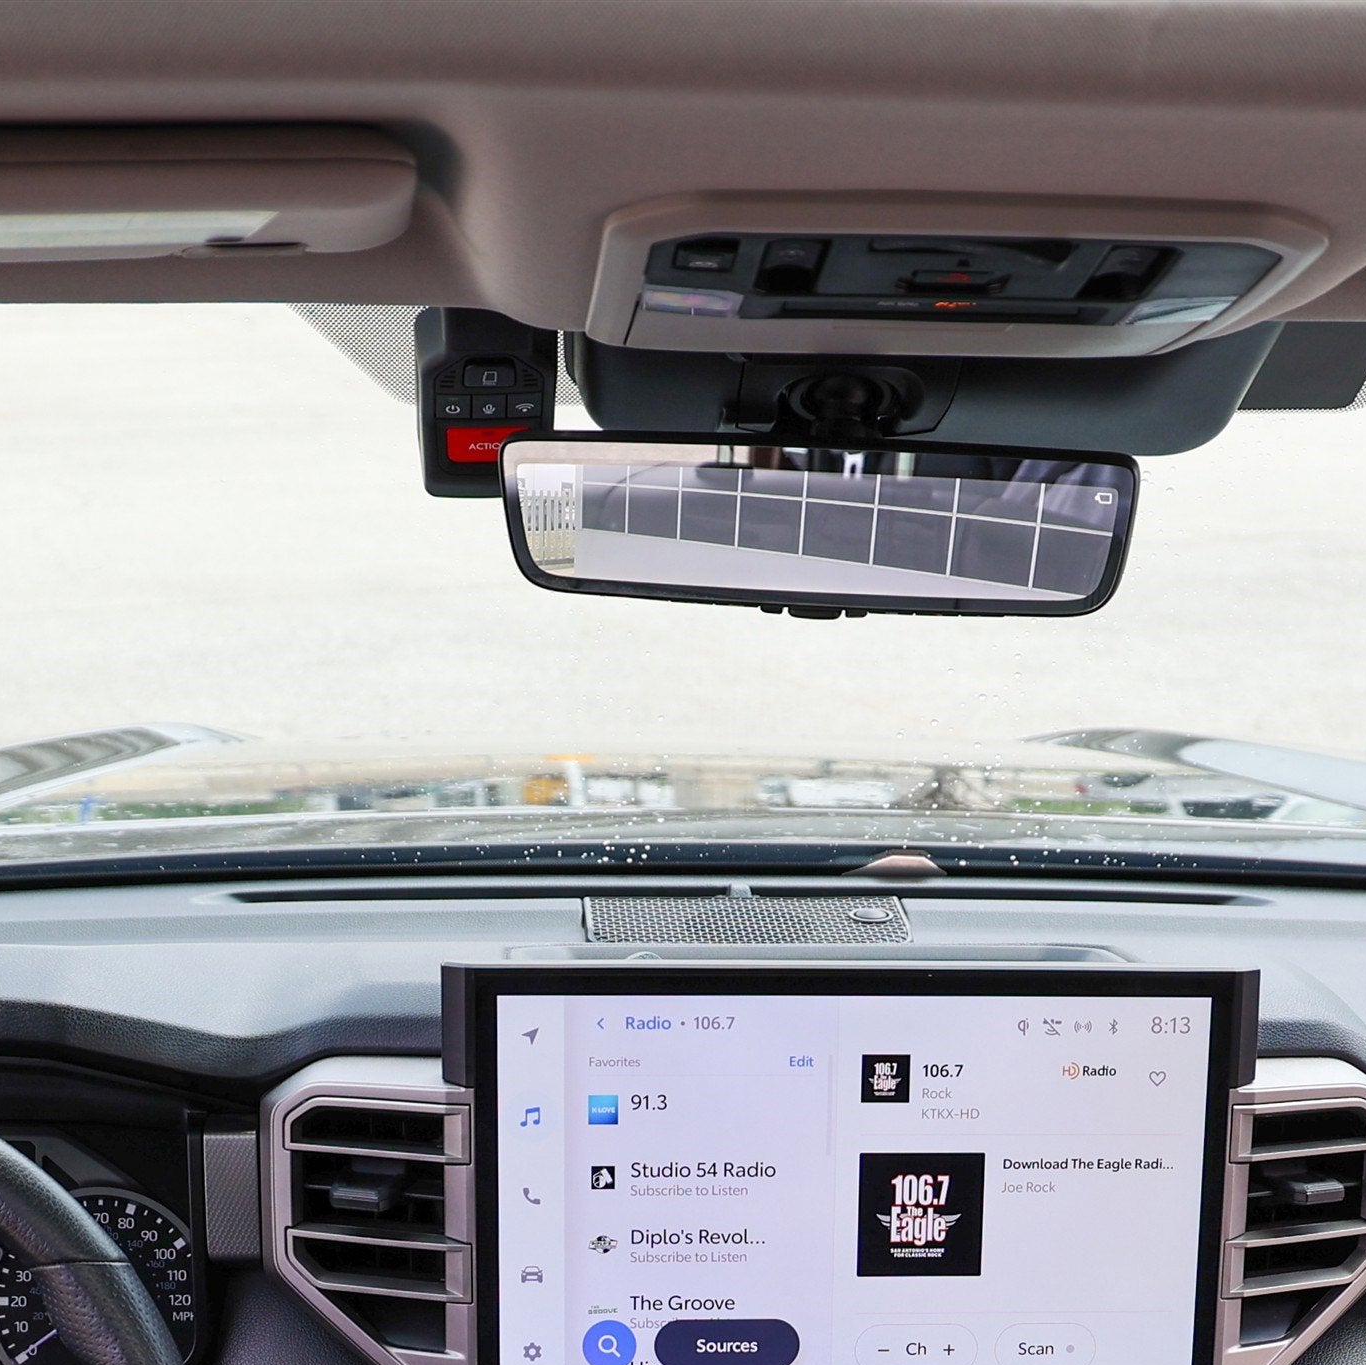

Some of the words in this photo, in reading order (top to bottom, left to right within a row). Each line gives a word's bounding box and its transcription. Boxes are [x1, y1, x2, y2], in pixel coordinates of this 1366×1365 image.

[468, 442, 502, 451] ACTIO
[625, 1016, 672, 1030] Radio
[693, 1016, 736, 1031] 106.7
[1150, 1016, 1192, 1035] 8:13
[588, 1056, 641, 1068] Favorites
[789, 1055, 815, 1068] Edit
[874, 1062, 898, 1076] 106.7
[922, 1064, 964, 1078] 106.7
[1082, 1064, 1117, 1077] Radio
[922, 1087, 952, 1099] Rock
[630, 1094, 668, 1111] 91.3
[921, 1108, 980, 1120] KTKX-HD
[630, 1161, 692, 1178] Studio
[696, 1162, 718, 1178] 54
[723, 1161, 777, 1178] Radio
[1002, 1157, 1068, 1171] Download
[1071, 1157, 1094, 1171] The
[1096, 1158, 1132, 1173] Eagle
[630, 1184, 693, 1197] Subscribe
[696, 1185, 709, 1197] to
[711, 1184, 749, 1197] Listen
[891, 1174, 950, 1206] 106.7
[1001, 1181, 1023, 1193] Joe
[1025, 1181, 1056, 1193] Rock
[906, 1206, 924, 1216] The
[93, 1212, 110, 1224] 70
[117, 1217, 135, 1229] 80
[890, 1206, 947, 1246] Eagle
[141, 1230, 158, 1242] 90
[630, 1229, 693, 1248] Diplo's
[153, 1248, 176, 1260] 100
[630, 1251, 693, 1264] Subscribe
[695, 1252, 708, 1264] to
[710, 1251, 748, 1264] Listen
[15, 1270, 32, 1283] 30
[166, 1269, 187, 1281] 110
[10, 1295, 27, 1307] 20
[168, 1293, 191, 1306] 120
[630, 1295, 663, 1311] The
[667, 1295, 736, 1312] Groove
[13, 1321, 29, 1333] 10
[695, 1338, 758, 1354] Sources
[905, 1342, 927, 1356] Ch
[1018, 1342, 1055, 1356] Scan
